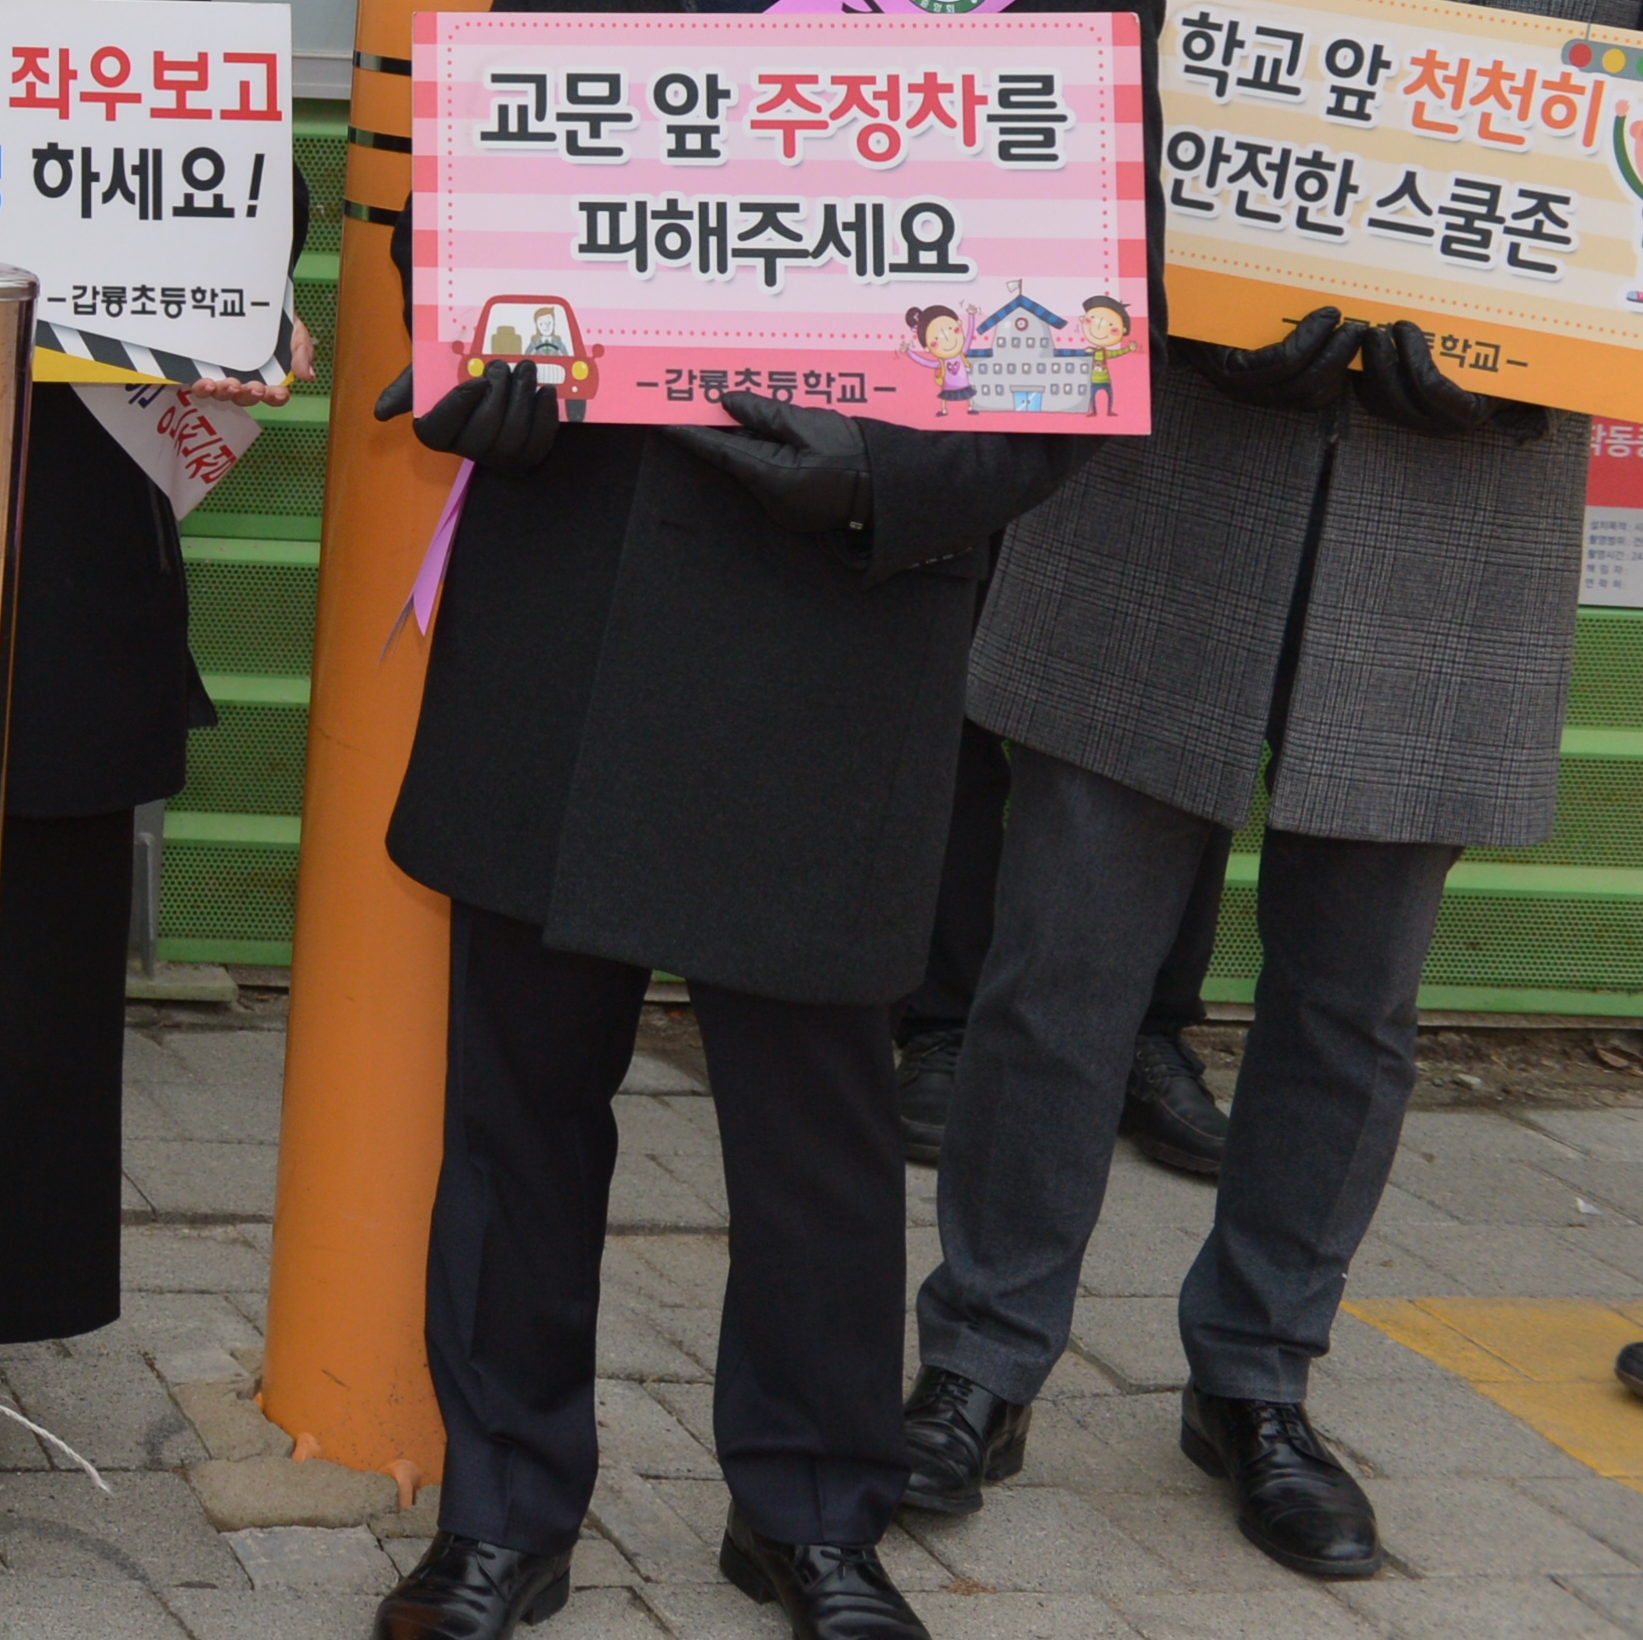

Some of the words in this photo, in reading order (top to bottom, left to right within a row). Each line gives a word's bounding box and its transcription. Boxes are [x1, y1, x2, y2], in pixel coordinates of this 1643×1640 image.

[8, 46, 283, 122] 좌우보고
[479, 73, 633, 157] 교문
[653, 74, 730, 160] 앞
[749, 73, 1068, 162] 주정차를
[1181, 11, 1303, 98] 학교
[1323, 37, 1392, 123] 앞
[1403, 48, 1604, 149] 천천히
[32, 142, 265, 221] 하세요!
[1166, 131, 1359, 238] 안전한
[1368, 170, 1572, 274] 스쿨존
[578, 198, 971, 288] 피해주세요
